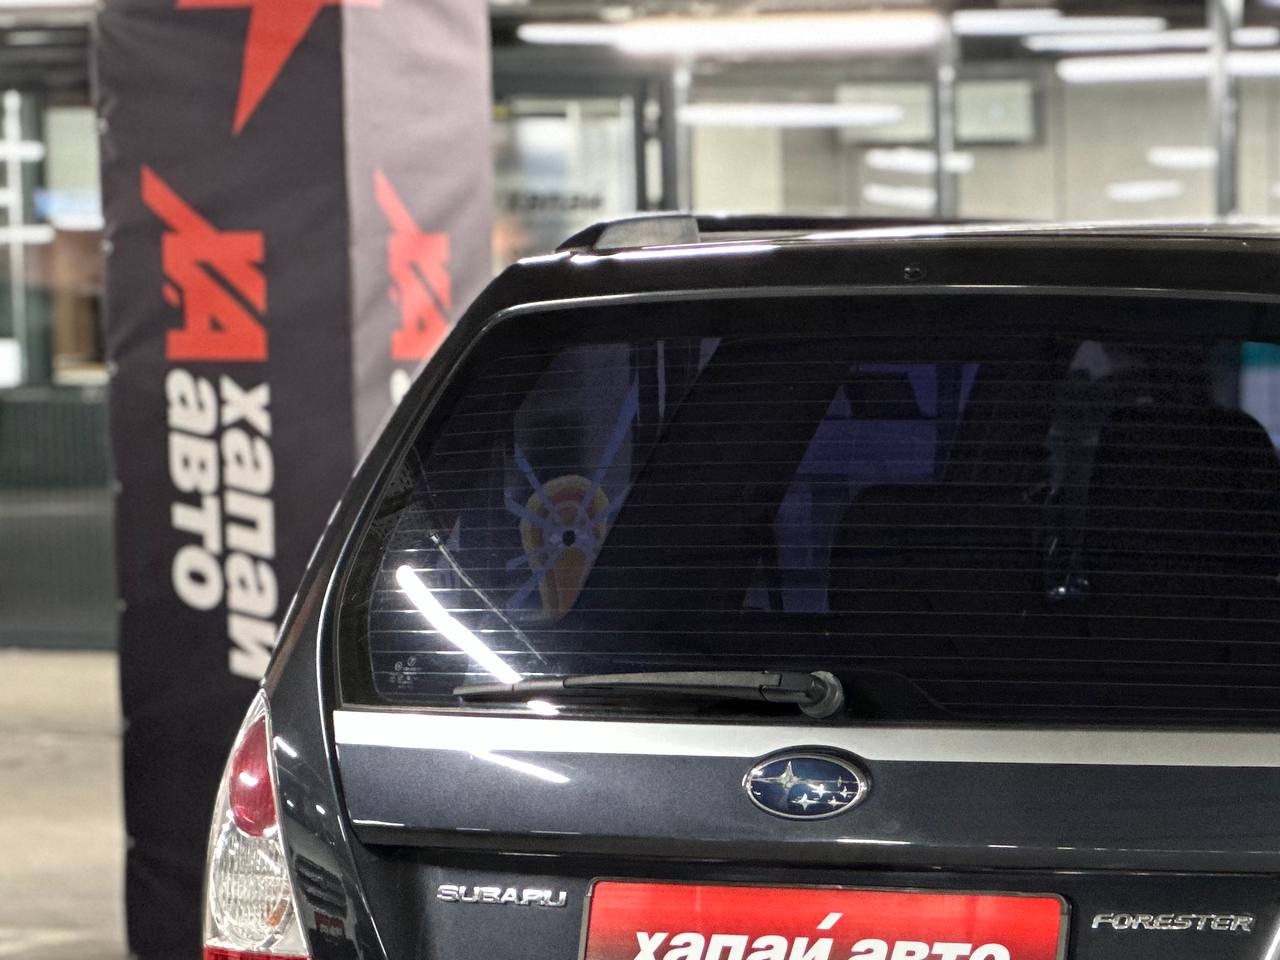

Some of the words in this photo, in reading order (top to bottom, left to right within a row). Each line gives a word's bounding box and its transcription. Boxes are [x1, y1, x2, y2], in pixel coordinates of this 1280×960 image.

[165, 368, 225, 610] авто
[436, 884, 568, 907] SUBARU
[1091, 912, 1254, 932] FORESTER
